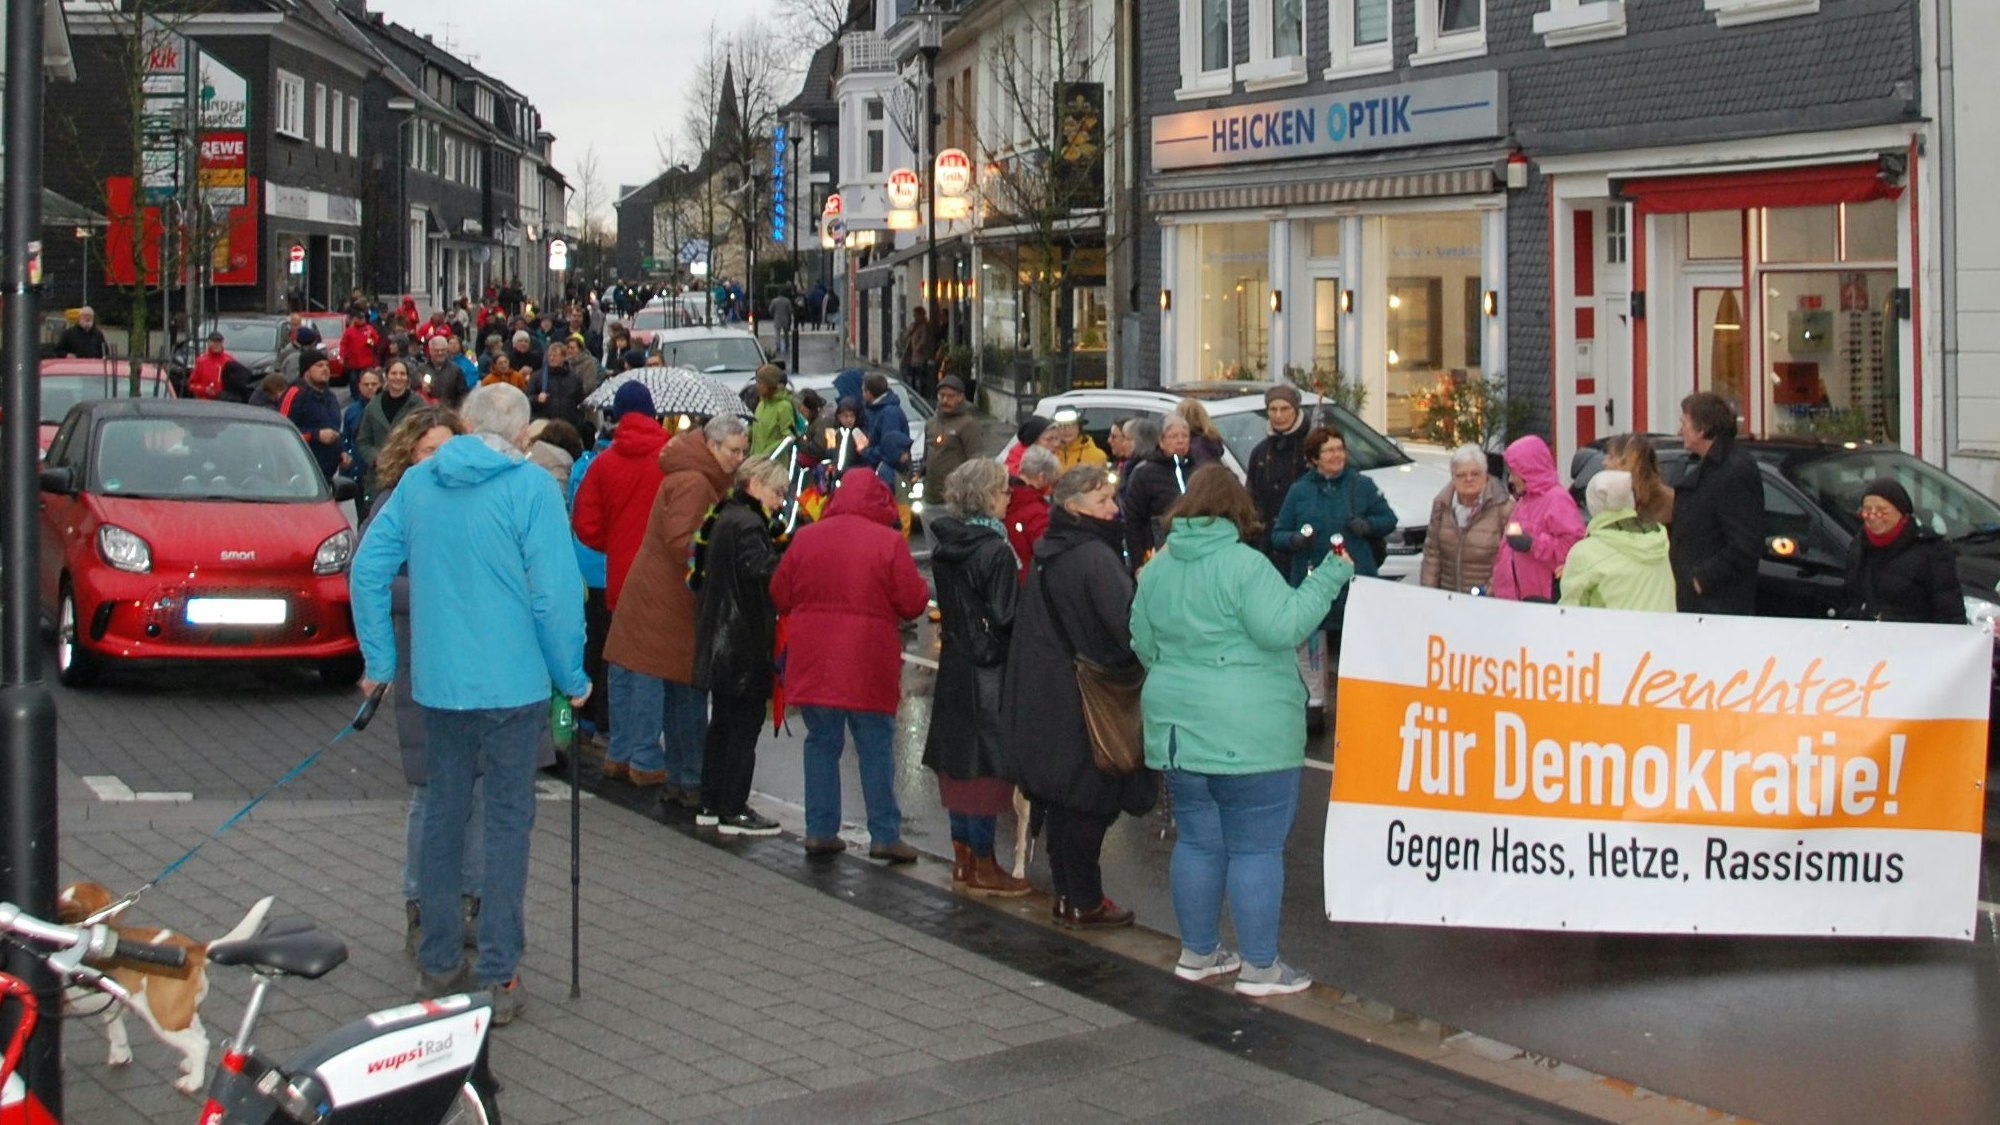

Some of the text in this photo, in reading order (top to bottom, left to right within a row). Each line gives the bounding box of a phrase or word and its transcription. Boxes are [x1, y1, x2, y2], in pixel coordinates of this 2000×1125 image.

[201, 140, 244, 155] REWE
[1212, 95, 1412, 152] HEICKEN OPTIK
[220, 550, 256, 561] smart
[1427, 634, 1890, 717] Burscheid leuchtet
[1397, 702, 1907, 816] für Demokratie!
[1387, 820, 1905, 884] Gegen Hass, Hetze, Rassismus
